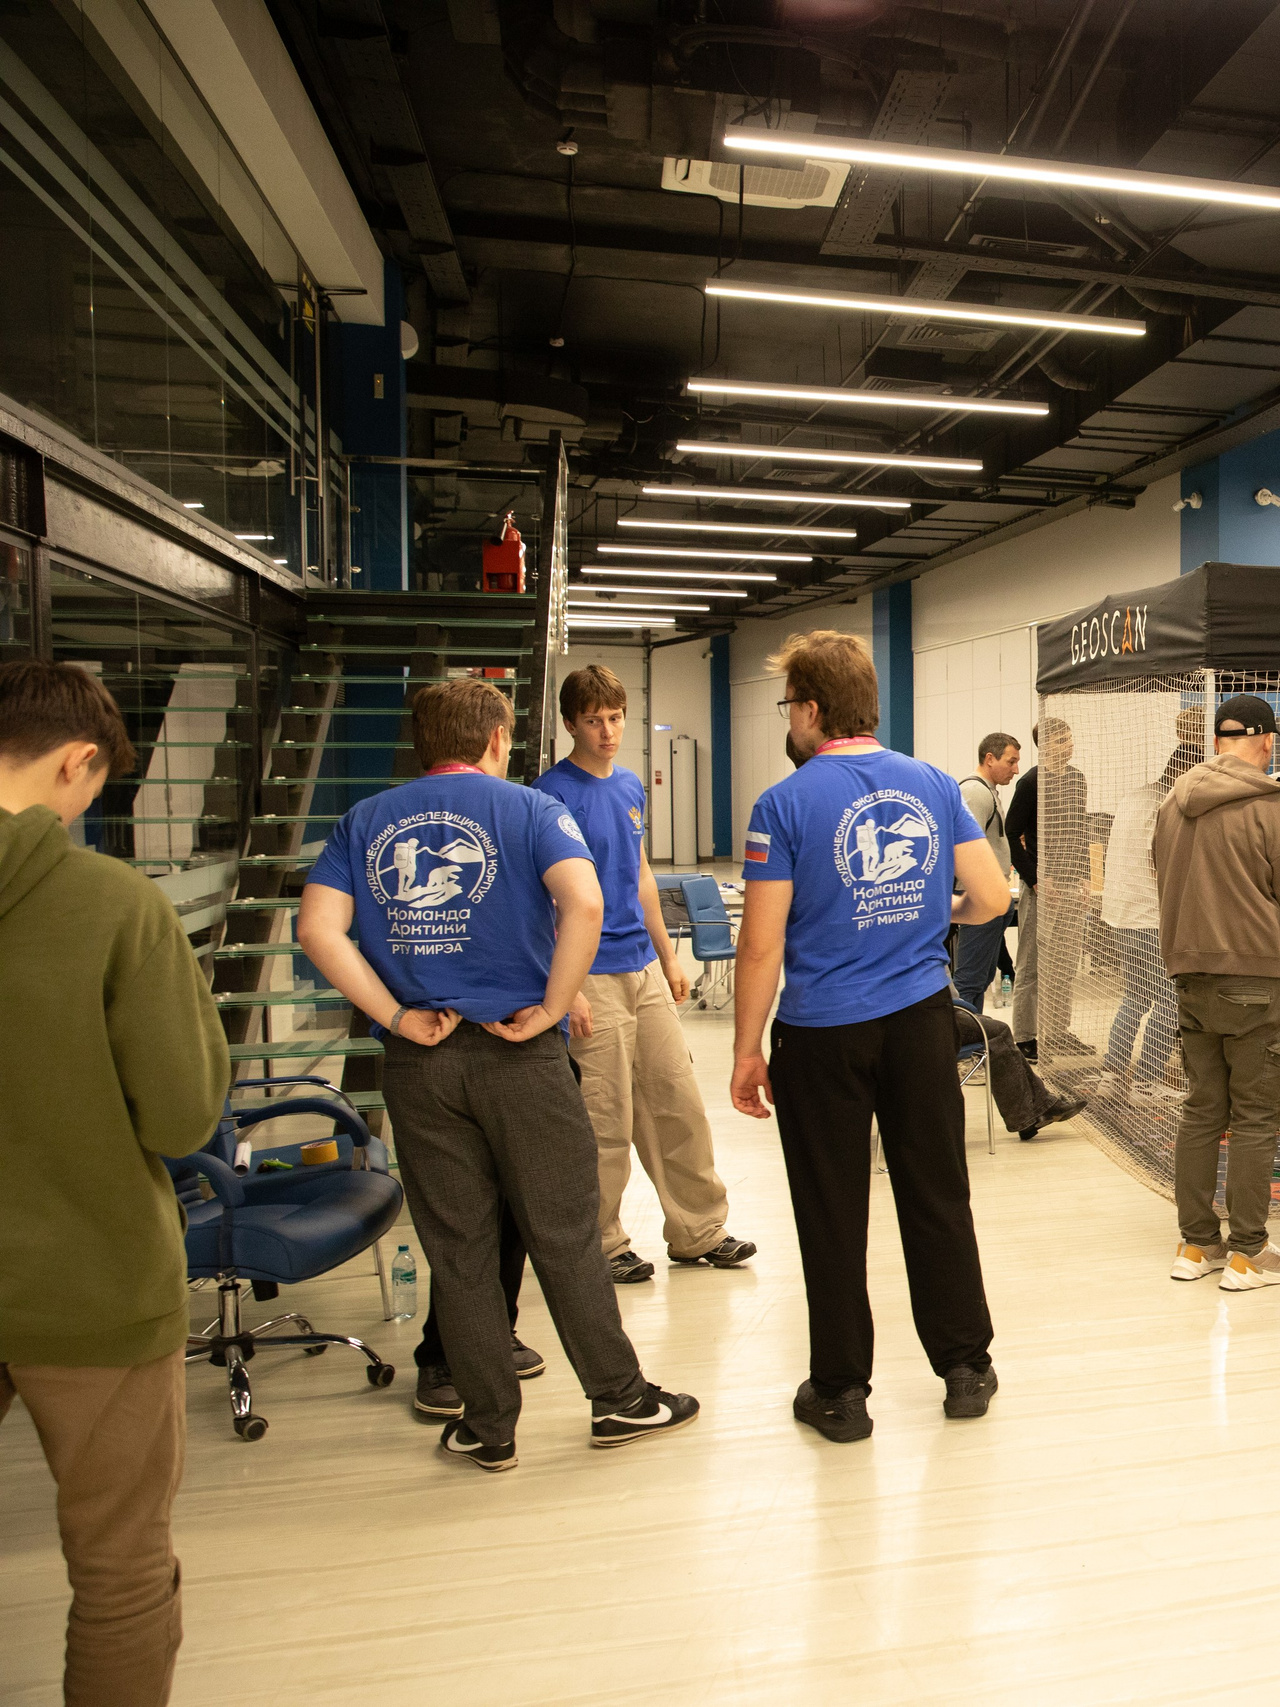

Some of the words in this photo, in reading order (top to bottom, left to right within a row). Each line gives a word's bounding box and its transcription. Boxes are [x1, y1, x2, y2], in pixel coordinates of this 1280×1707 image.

[1071, 604, 1147, 666] GEOSCAN
[365, 823, 397, 906] СТУДЕНЧЕСКИЙ
[398, 811, 498, 858] ЭКСПЕДИЦИОННЫЙ
[471, 859, 498, 905] КОРПУС
[924, 834, 940, 876] КОРПУС
[853, 879, 925, 900] Команда
[387, 907, 471, 922] Команда
[856, 893, 922, 915] Арктики
[877, 911, 919, 926] МИРЭА
[390, 923, 467, 938] Арктики
[392, 944, 411, 955] РТУ
[414, 943, 463, 956] МИРЭА
